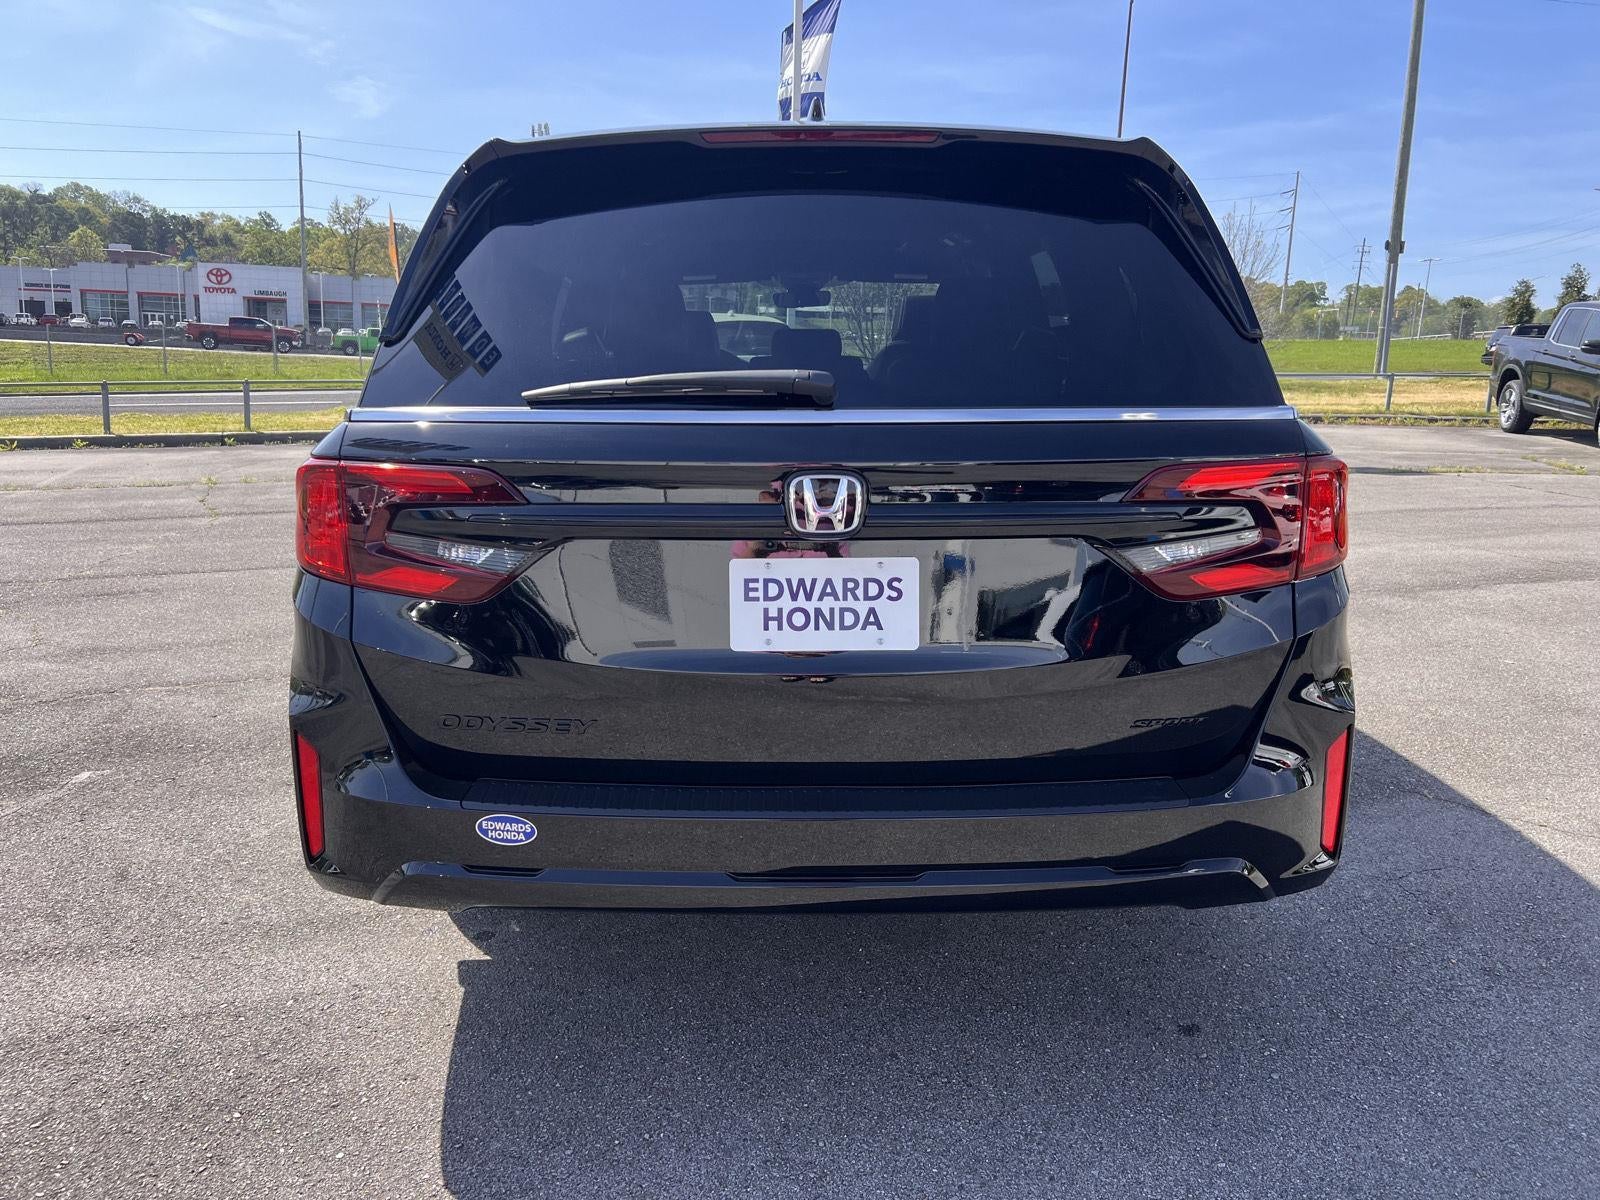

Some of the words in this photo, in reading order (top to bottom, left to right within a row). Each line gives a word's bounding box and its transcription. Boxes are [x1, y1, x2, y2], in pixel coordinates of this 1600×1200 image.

[203, 286, 237, 294] TOYOTA
[254, 289, 287, 297] LIMBAUGH
[743, 577, 903, 602] EDWARDS
[762, 606, 884, 631] HONDA
[440, 714, 598, 734] ODYSSEY
[482, 820, 531, 832] EDWARDS
[488, 830, 526, 841] HONDA
